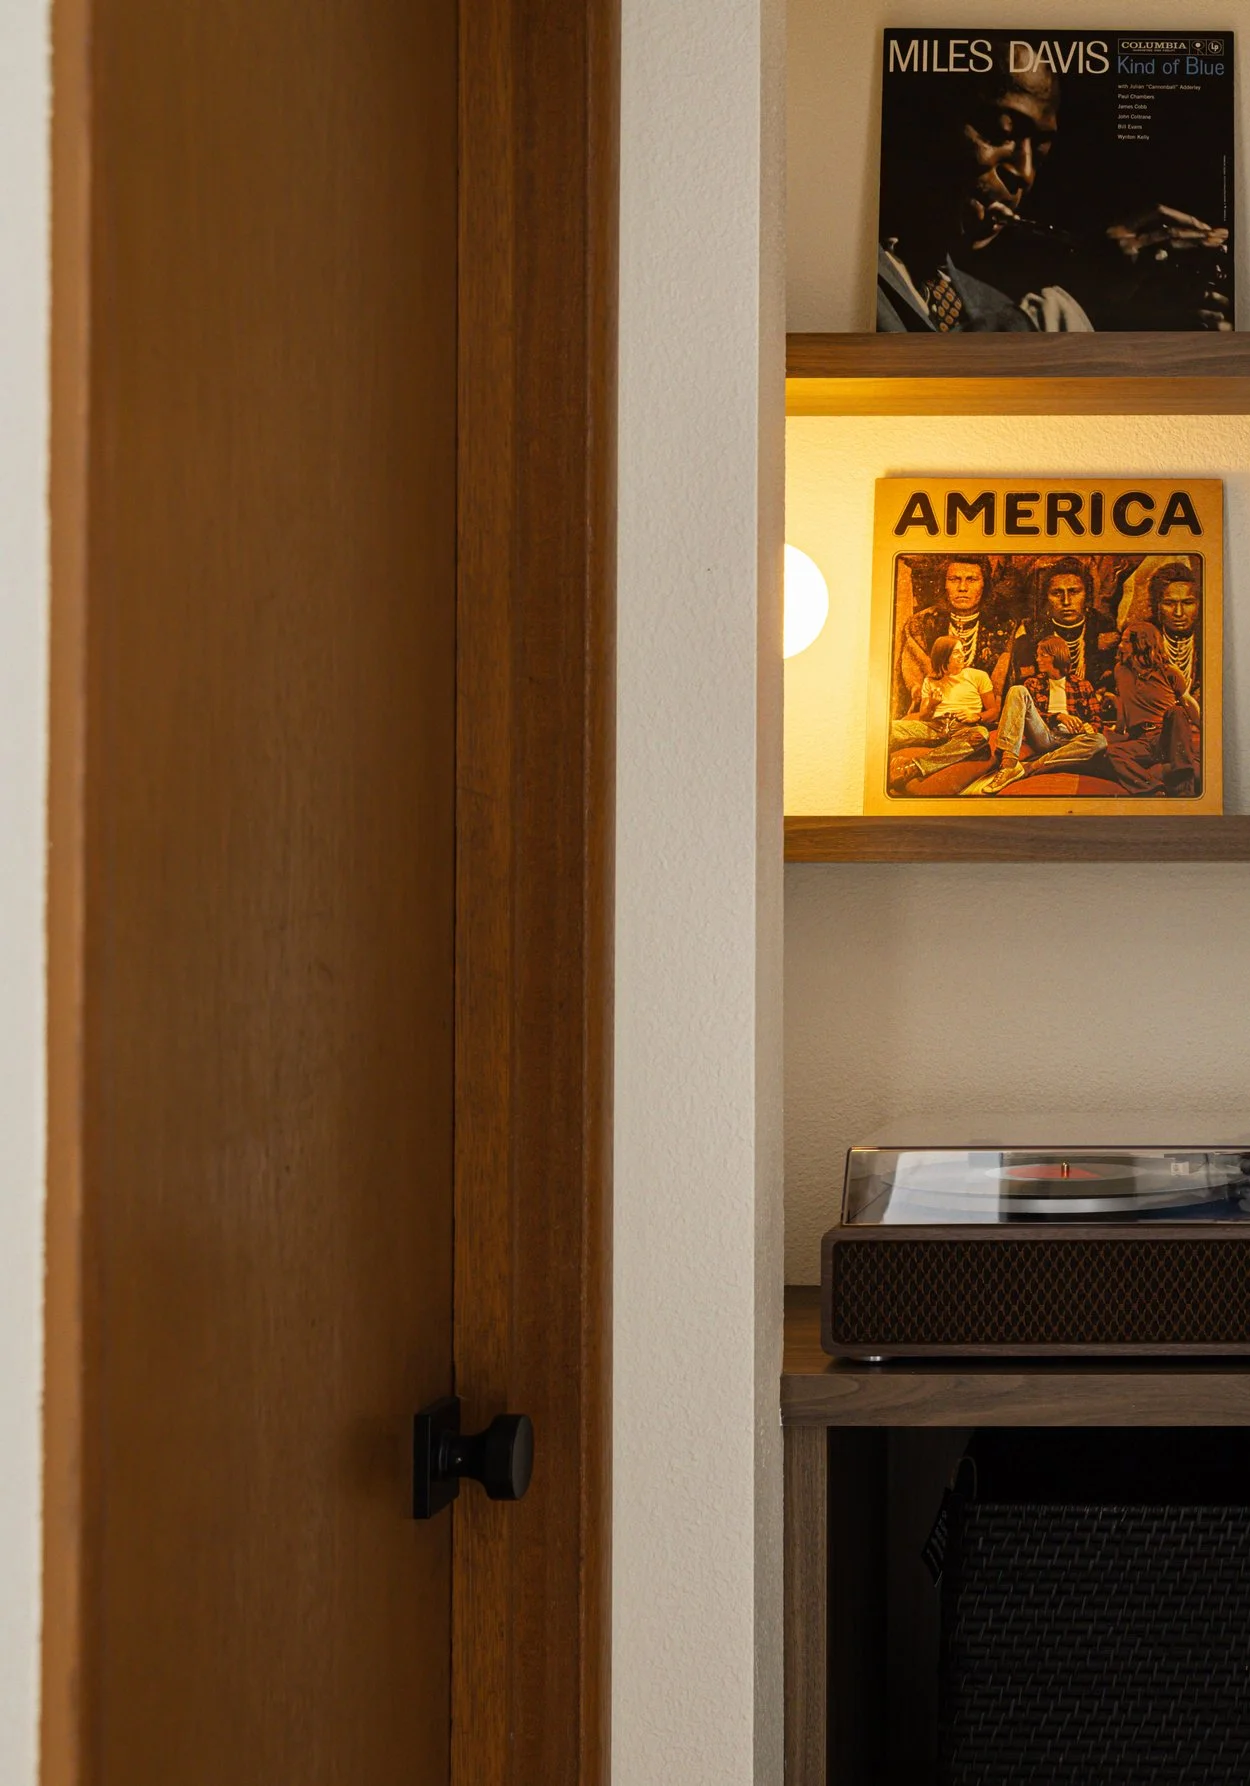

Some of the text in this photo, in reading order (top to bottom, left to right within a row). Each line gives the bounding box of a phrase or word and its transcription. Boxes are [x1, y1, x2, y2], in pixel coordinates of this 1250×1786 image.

[889, 39, 1110, 74] MILES DAVIS
[1121, 41, 1187, 50] COLUMBIA
[1117, 55, 1225, 75] Kind of Blue
[893, 490, 1204, 537] AMERICA
